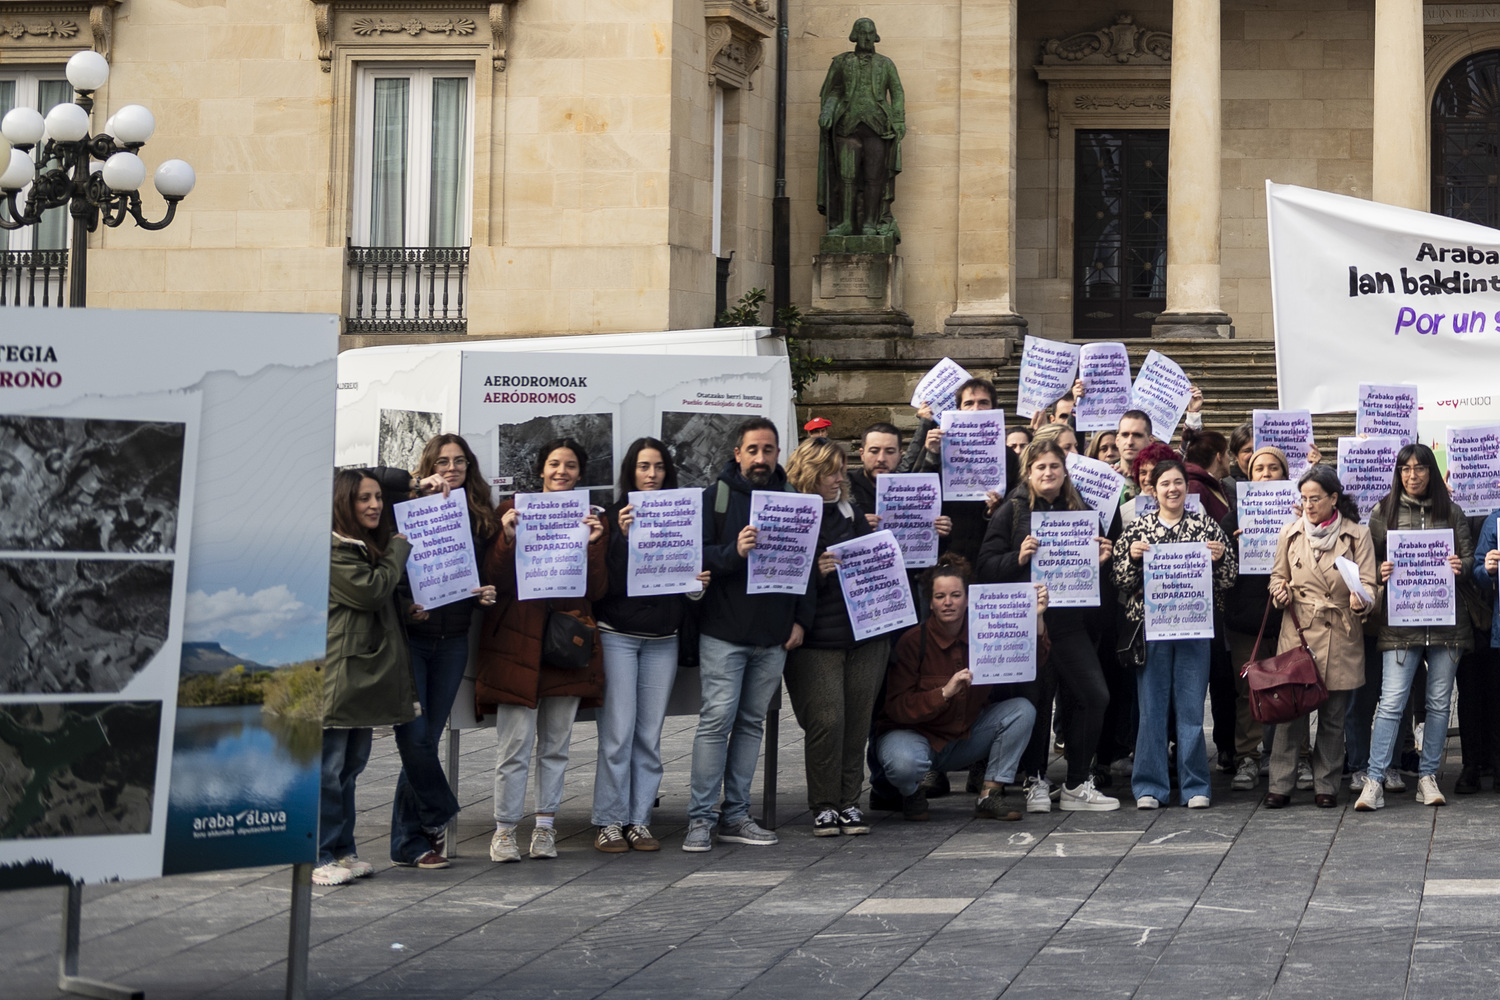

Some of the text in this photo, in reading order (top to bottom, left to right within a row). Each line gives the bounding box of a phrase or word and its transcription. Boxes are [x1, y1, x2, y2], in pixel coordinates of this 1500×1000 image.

[1394, 306, 1446, 335] Por
[1452, 310, 1486, 334] un
[484, 375, 587, 388] AERODROMOAK
[483, 389, 576, 404] AERÓDROMOS
[549, 511, 583, 519] sozialeko
[540, 522, 579, 530] baldintzak
[536, 533, 570, 541] hobetuz,
[525, 542, 582, 552] EKIPARAZIOA!
[1185, 551, 1201, 559] esku
[1152, 591, 1204, 599] EKIPARAZIOA!
[193, 812, 234, 830] araba
